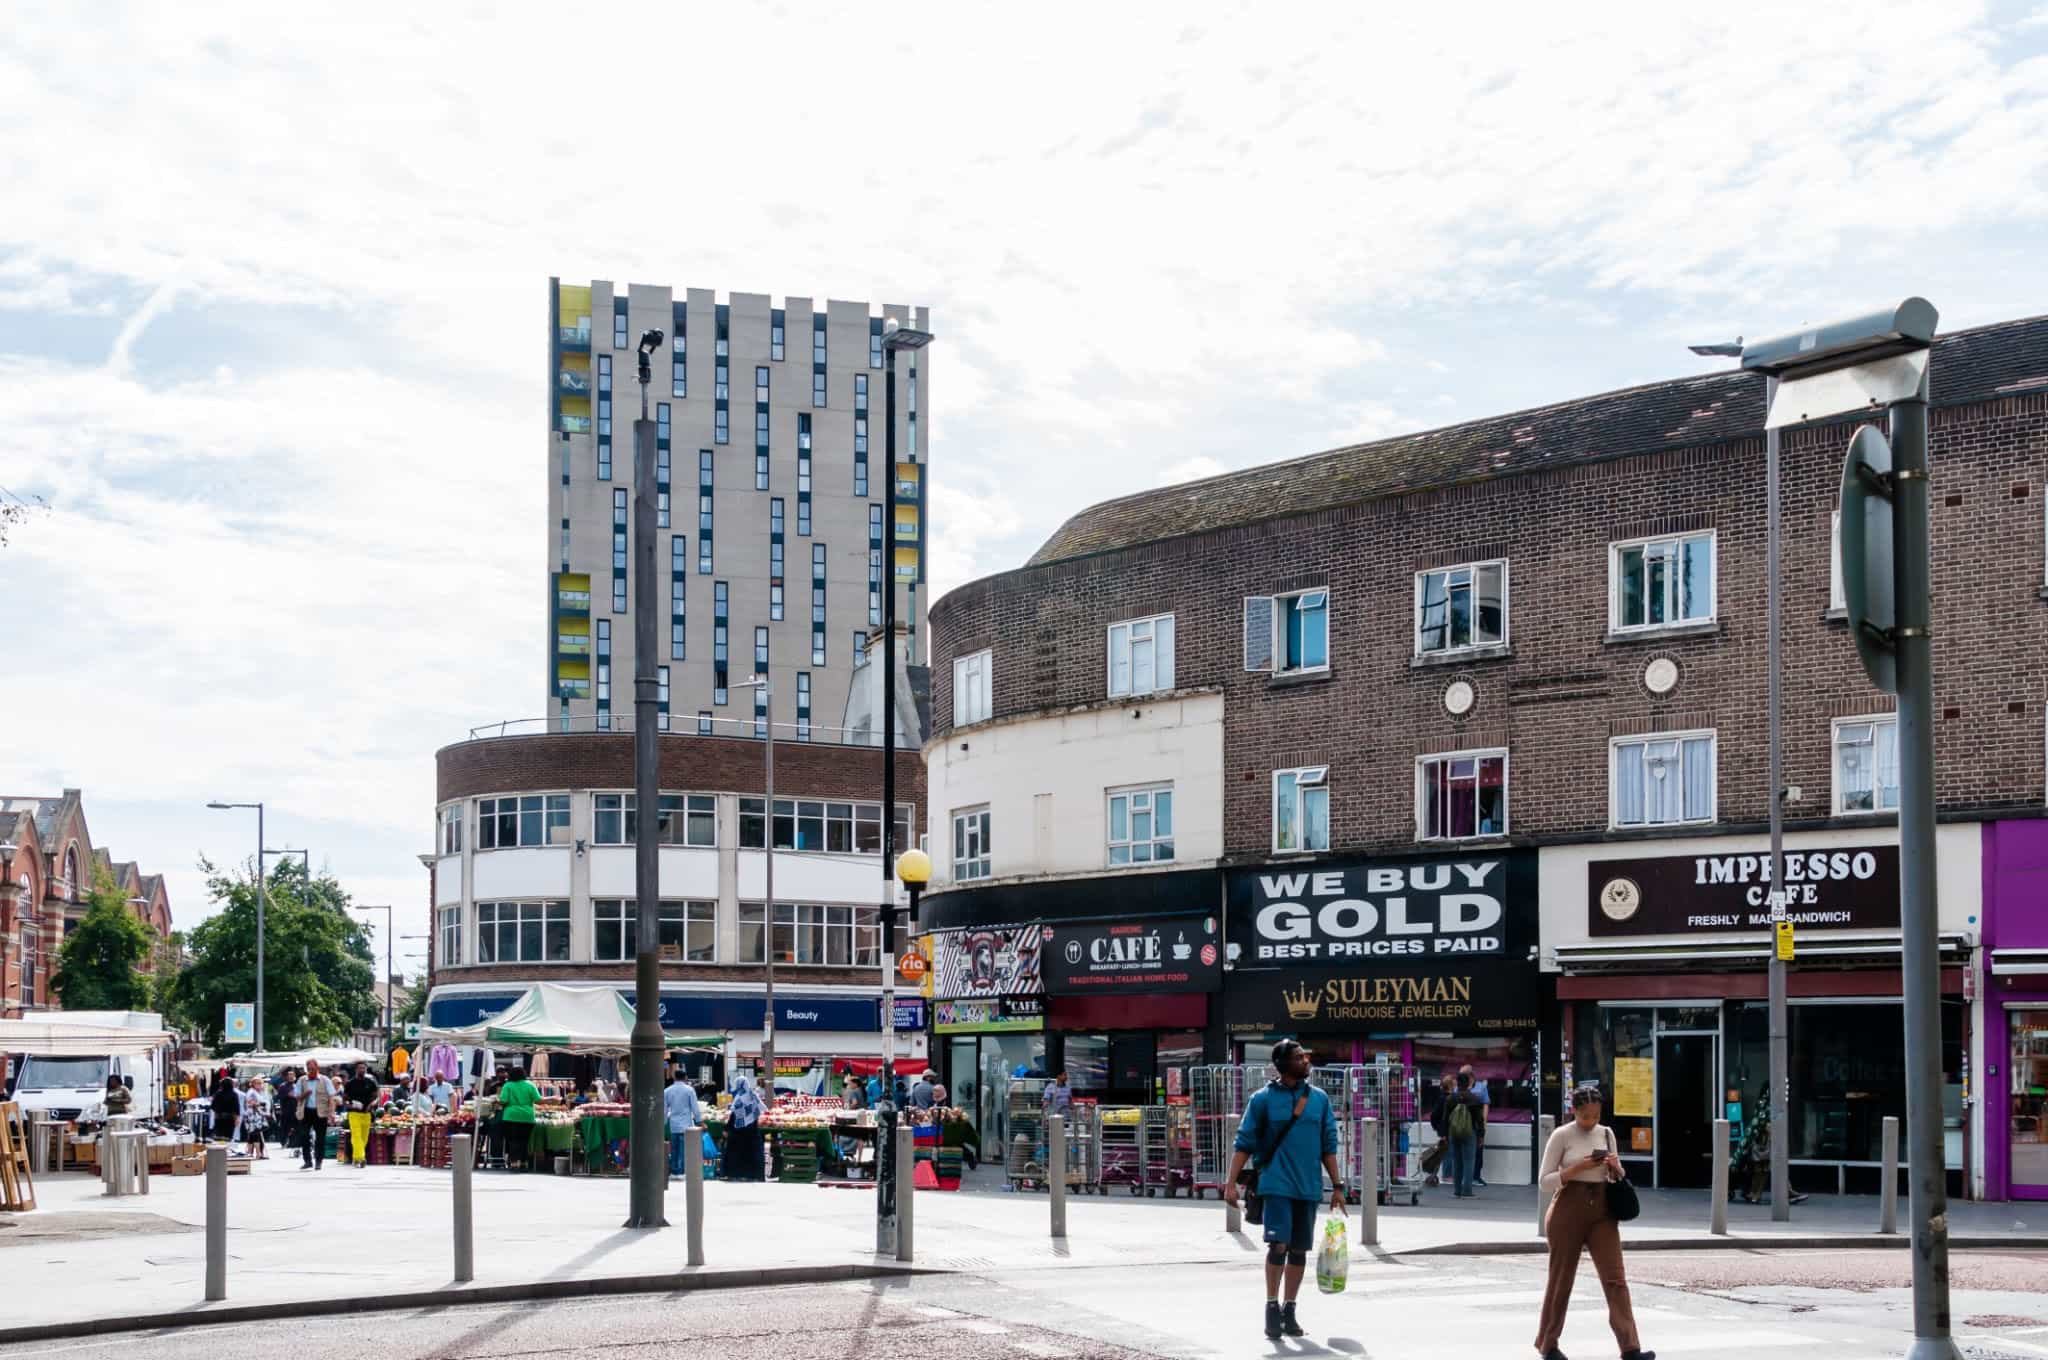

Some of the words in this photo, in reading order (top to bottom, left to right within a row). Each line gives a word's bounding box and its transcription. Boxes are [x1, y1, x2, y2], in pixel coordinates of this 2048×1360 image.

[1259, 873, 1345, 899] WE
[1366, 861, 1499, 893] BUY
[1256, 893, 1502, 940] GOLD
[1687, 914, 1740, 926] FRESHLY
[1748, 914, 1774, 925] MAD
[1786, 911, 1851, 923] SANDWICH
[1090, 929, 1161, 963] CAFÉ
[1258, 943, 1321, 959] BEST
[1328, 940, 1425, 956] PRICES
[1434, 937, 1500, 953] PAID
[902, 955, 924, 970] ria
[1115, 975, 1143, 984] ITALIAN
[1167, 973, 1188, 982] FOOD
[1325, 977, 1471, 1004] SULEYMAN
[786, 1009, 818, 1022] Beauty
[1327, 1006, 1396, 1018] TURQUOISE
[1400, 1005, 1471, 1017] JEWELLERY
[169, 1086, 187, 1097] SALE
